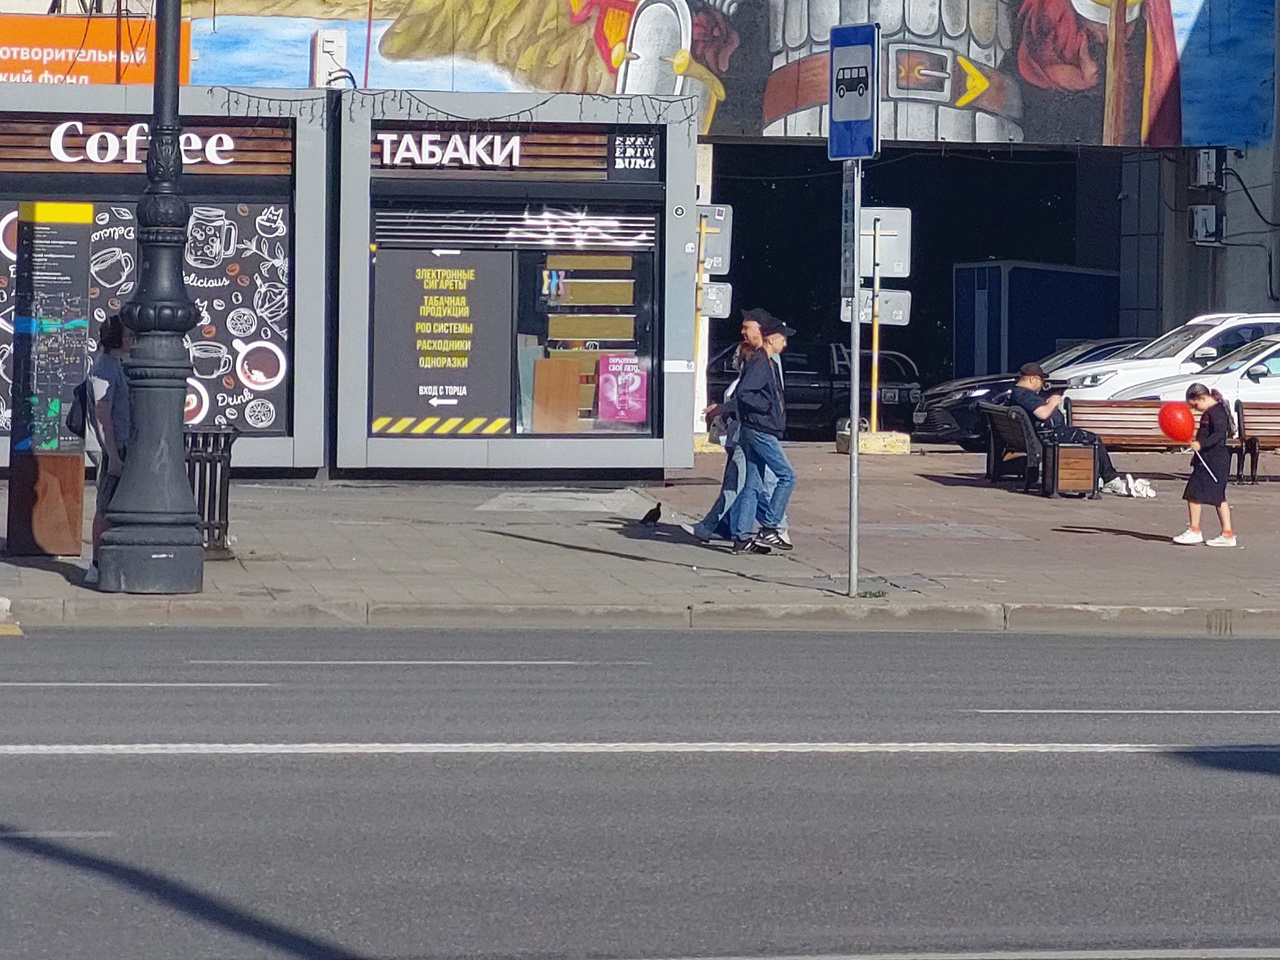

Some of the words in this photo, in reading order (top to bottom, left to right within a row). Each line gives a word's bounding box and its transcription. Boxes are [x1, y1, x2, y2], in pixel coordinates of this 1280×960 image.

[50, 121, 235, 165] Cofee
[376, 133, 520, 166] ТАБАКИ
[183, 270, 229, 287] elicious
[415, 269, 475, 280] ЭЛЕКТРОННЫЕ
[424, 280, 466, 290] СИГАРЕТЫ
[424, 296, 466, 306] ТАБАЧНАЯ
[419, 306, 469, 317] ПРОДУКЦИЯ
[433, 323, 473, 334] СИСТЕМЫ
[417, 340, 471, 351] РАСХОДНИКИ
[419, 357, 468, 368] ОДНОРАЗКИ
[418, 386, 438, 396] ВХОД
[439, 386, 444, 395] С
[445, 386, 467, 396] ТОРЦА
[217, 388, 254, 406] Drink
